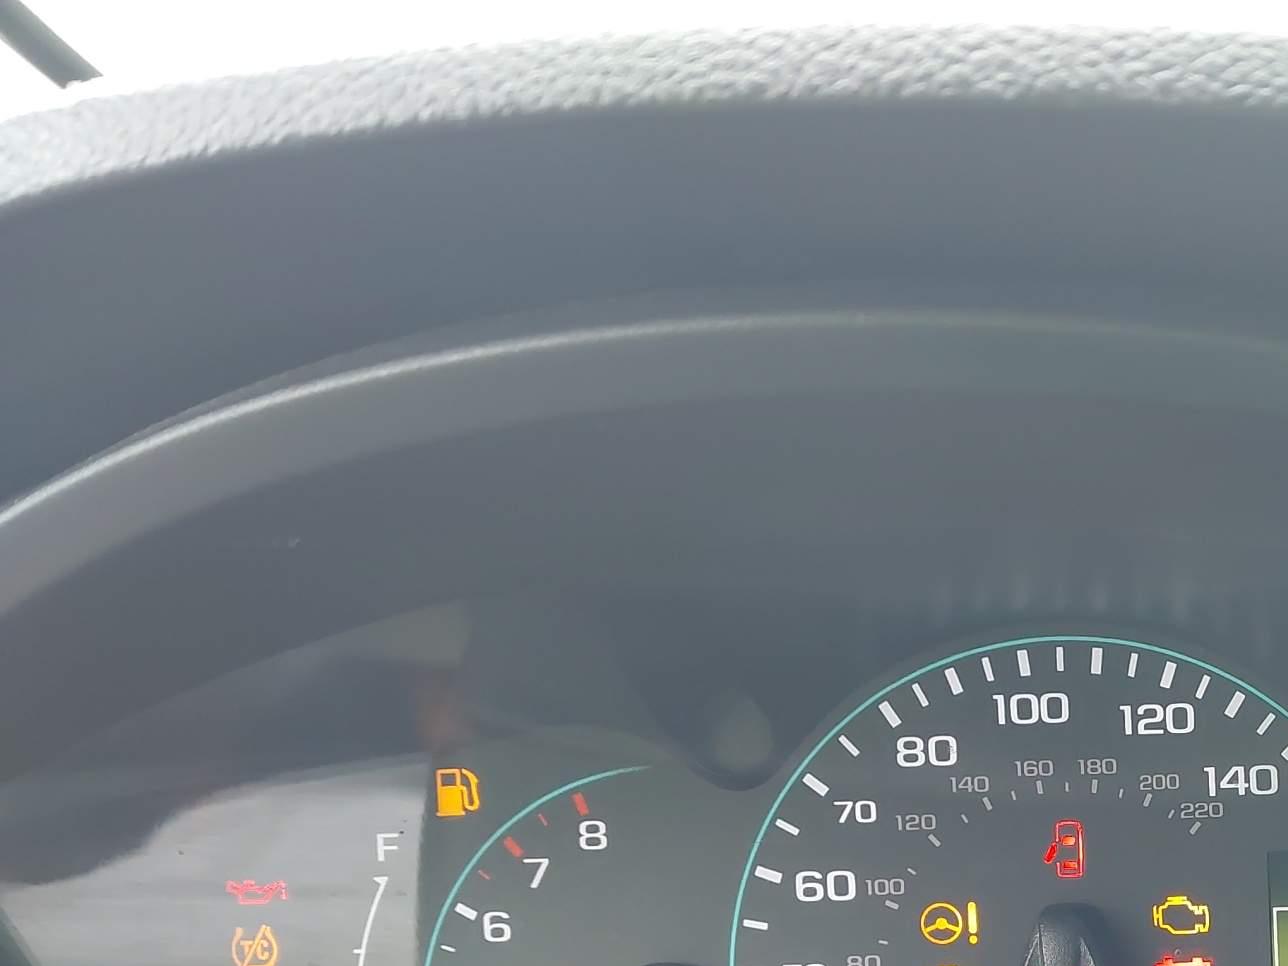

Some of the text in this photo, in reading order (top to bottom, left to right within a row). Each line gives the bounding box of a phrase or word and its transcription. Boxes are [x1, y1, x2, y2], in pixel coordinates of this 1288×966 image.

[992, 692, 1070, 725] 100
[1120, 702, 1194, 735] 120
[896, 736, 958, 767] 80
[1014, 759, 1054, 777] 160
[1078, 758, 1118, 776] 180
[1203, 764, 1278, 797] 140
[950, 776, 990, 794] 140
[1140, 774, 1180, 792] 200
[834, 800, 877, 824] 70
[895, 814, 936, 832] 120
[1180, 802, 1224, 820] 220
[376, 833, 400, 862] F
[578, 820, 608, 850] 8
[522, 858, 550, 888] 7
[794, 870, 856, 902] 60
[865, 878, 904, 896] 100
[482, 912, 512, 942] 6
